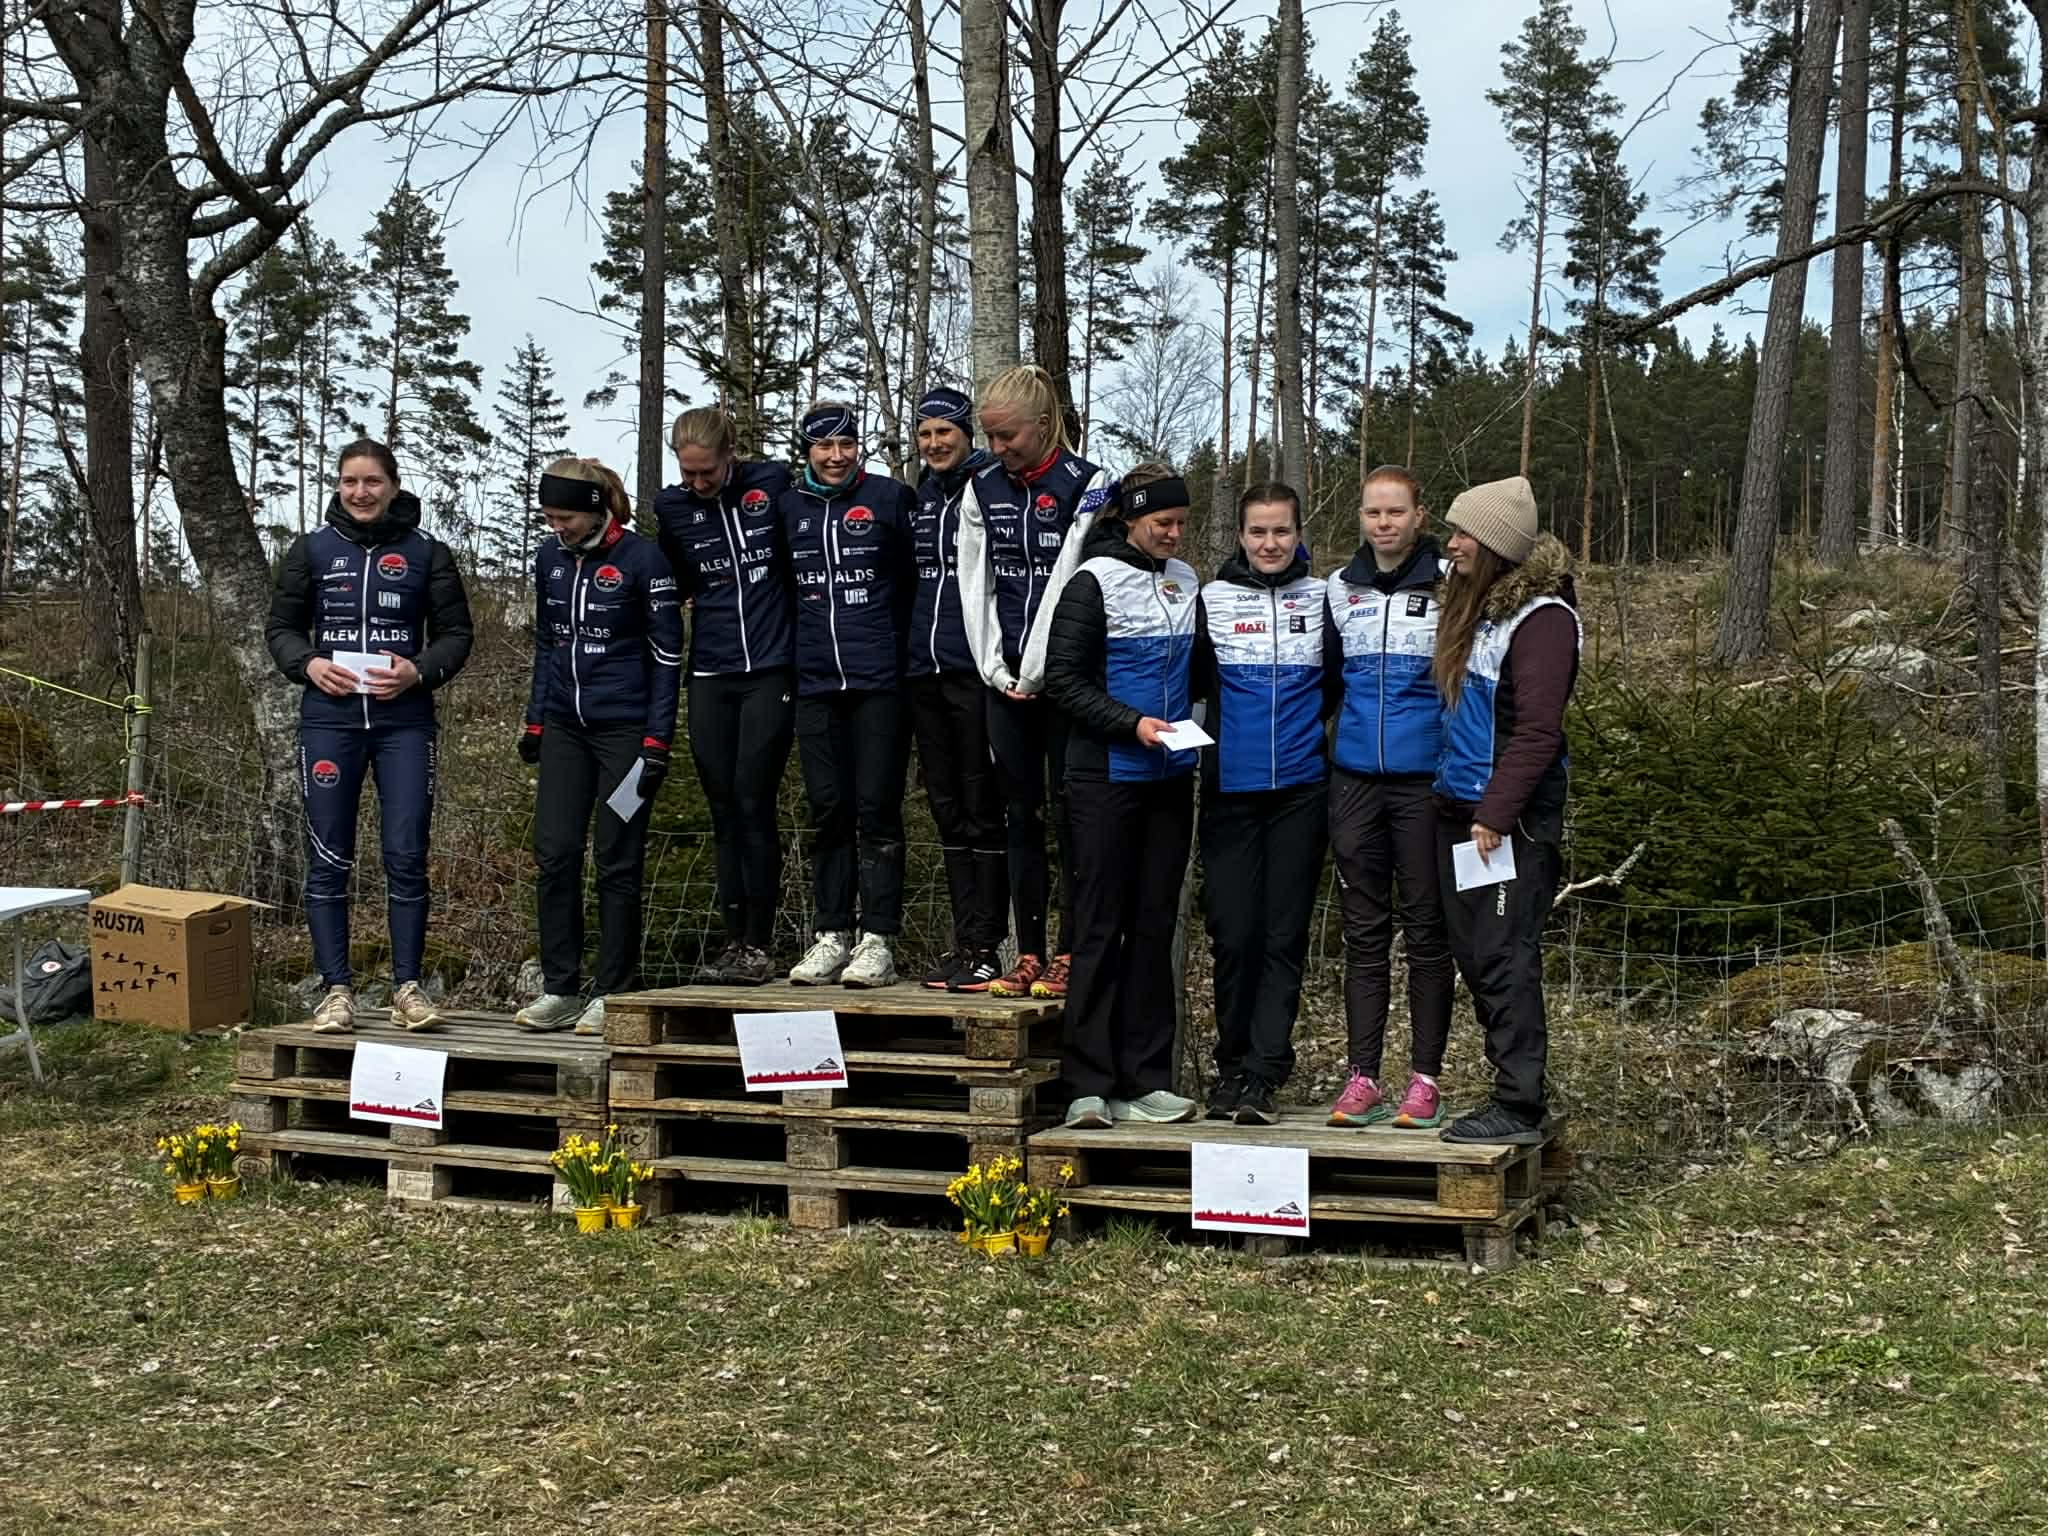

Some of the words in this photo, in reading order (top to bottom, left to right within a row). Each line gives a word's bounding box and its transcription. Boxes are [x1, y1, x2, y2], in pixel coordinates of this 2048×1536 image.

[700, 557, 731, 573] ALEW
[740, 547, 773, 564] ALDS
[834, 568, 875, 583] ALDS
[579, 626, 611, 638] ALDS
[1234, 621, 1266, 633] MAXI
[322, 629, 359, 642] ALEW
[369, 629, 409, 642] ALDS
[93, 910, 145, 935] RUSTA
[786, 1036, 792, 1047] 1
[394, 1071, 402, 1081] 2
[1247, 1173, 1256, 1184] 3
